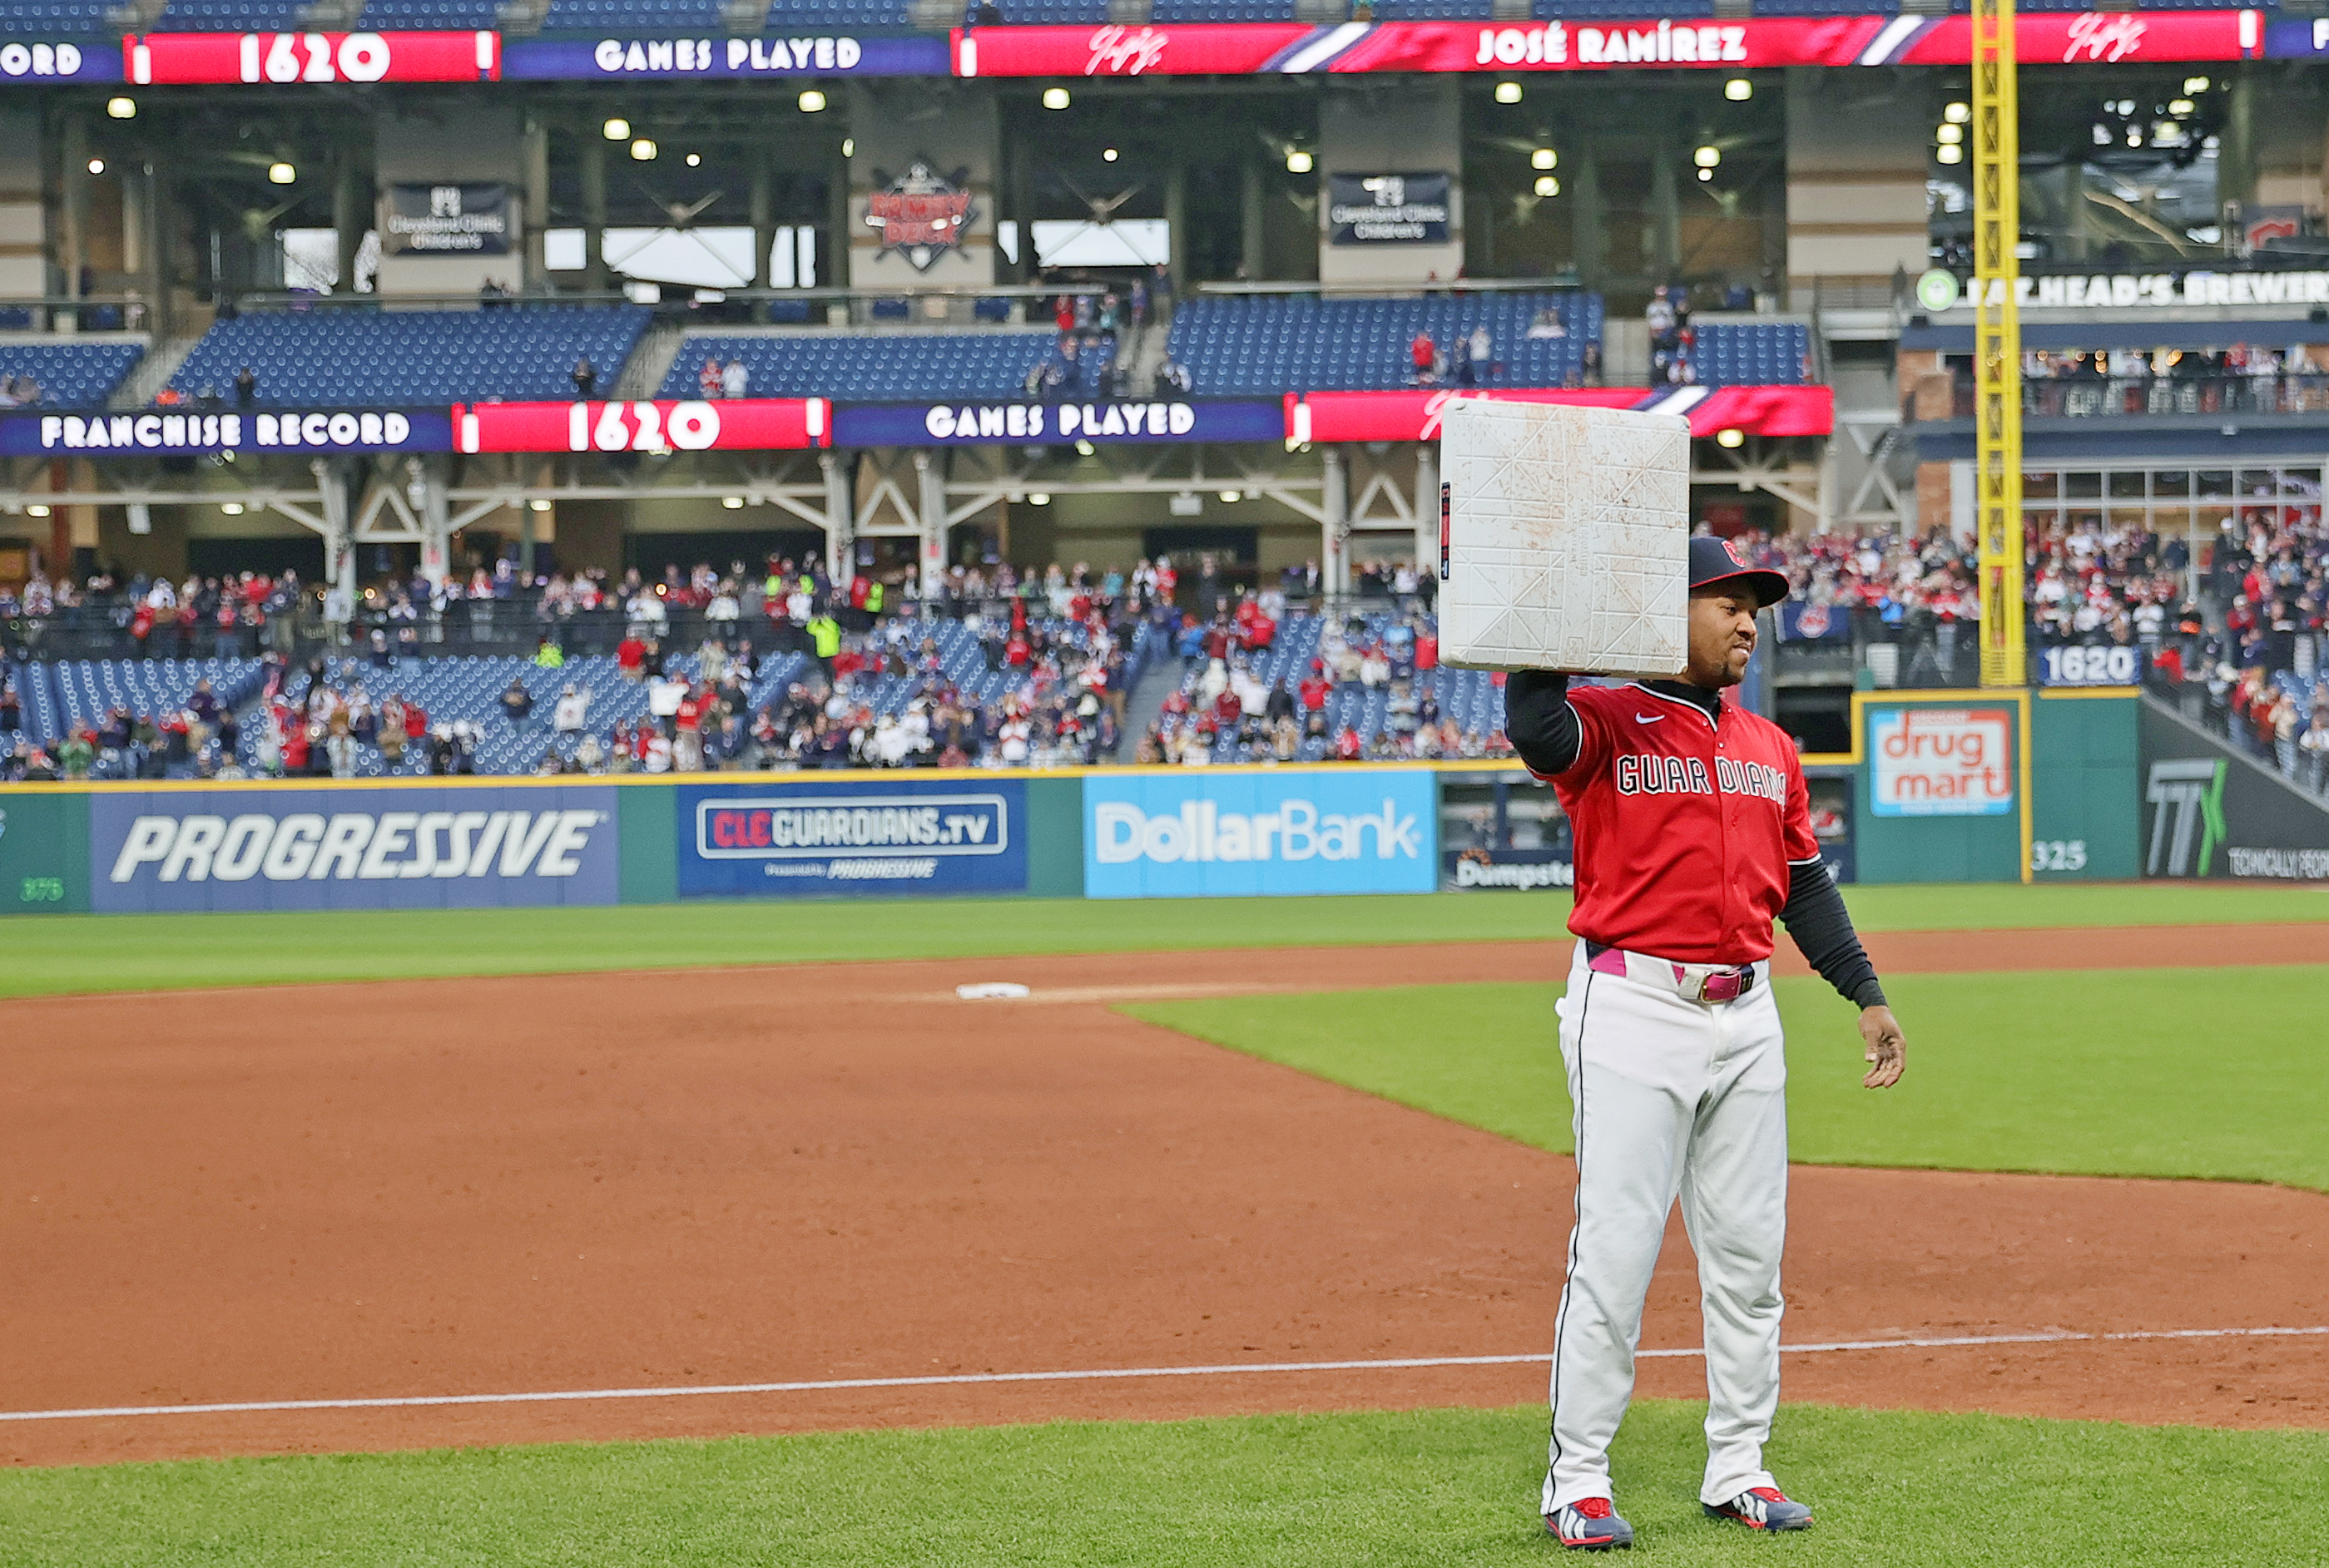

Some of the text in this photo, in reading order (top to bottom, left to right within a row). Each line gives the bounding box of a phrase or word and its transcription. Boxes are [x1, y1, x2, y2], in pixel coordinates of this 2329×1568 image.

[240, 32, 391, 83] 1620
[594, 37, 862, 72] GAMES PLAYED
[1475, 18, 1747, 65] JOSÉ RAMÍREZ
[2039, 274, 2175, 307] HEAD'S
[2183, 271, 2329, 304] BREWER
[41, 412, 410, 448] FRANCHISE RECORD
[569, 400, 721, 452] 1620
[925, 403, 1195, 438] GAMES PLAYED
[2044, 645, 2136, 681] 1620
[1885, 712, 1983, 767] drug
[1617, 754, 1786, 807] GUARDIANS
[1895, 766, 2010, 799] mart
[110, 809, 599, 883] PROGRESSIVE
[2030, 840, 2087, 871] 325
